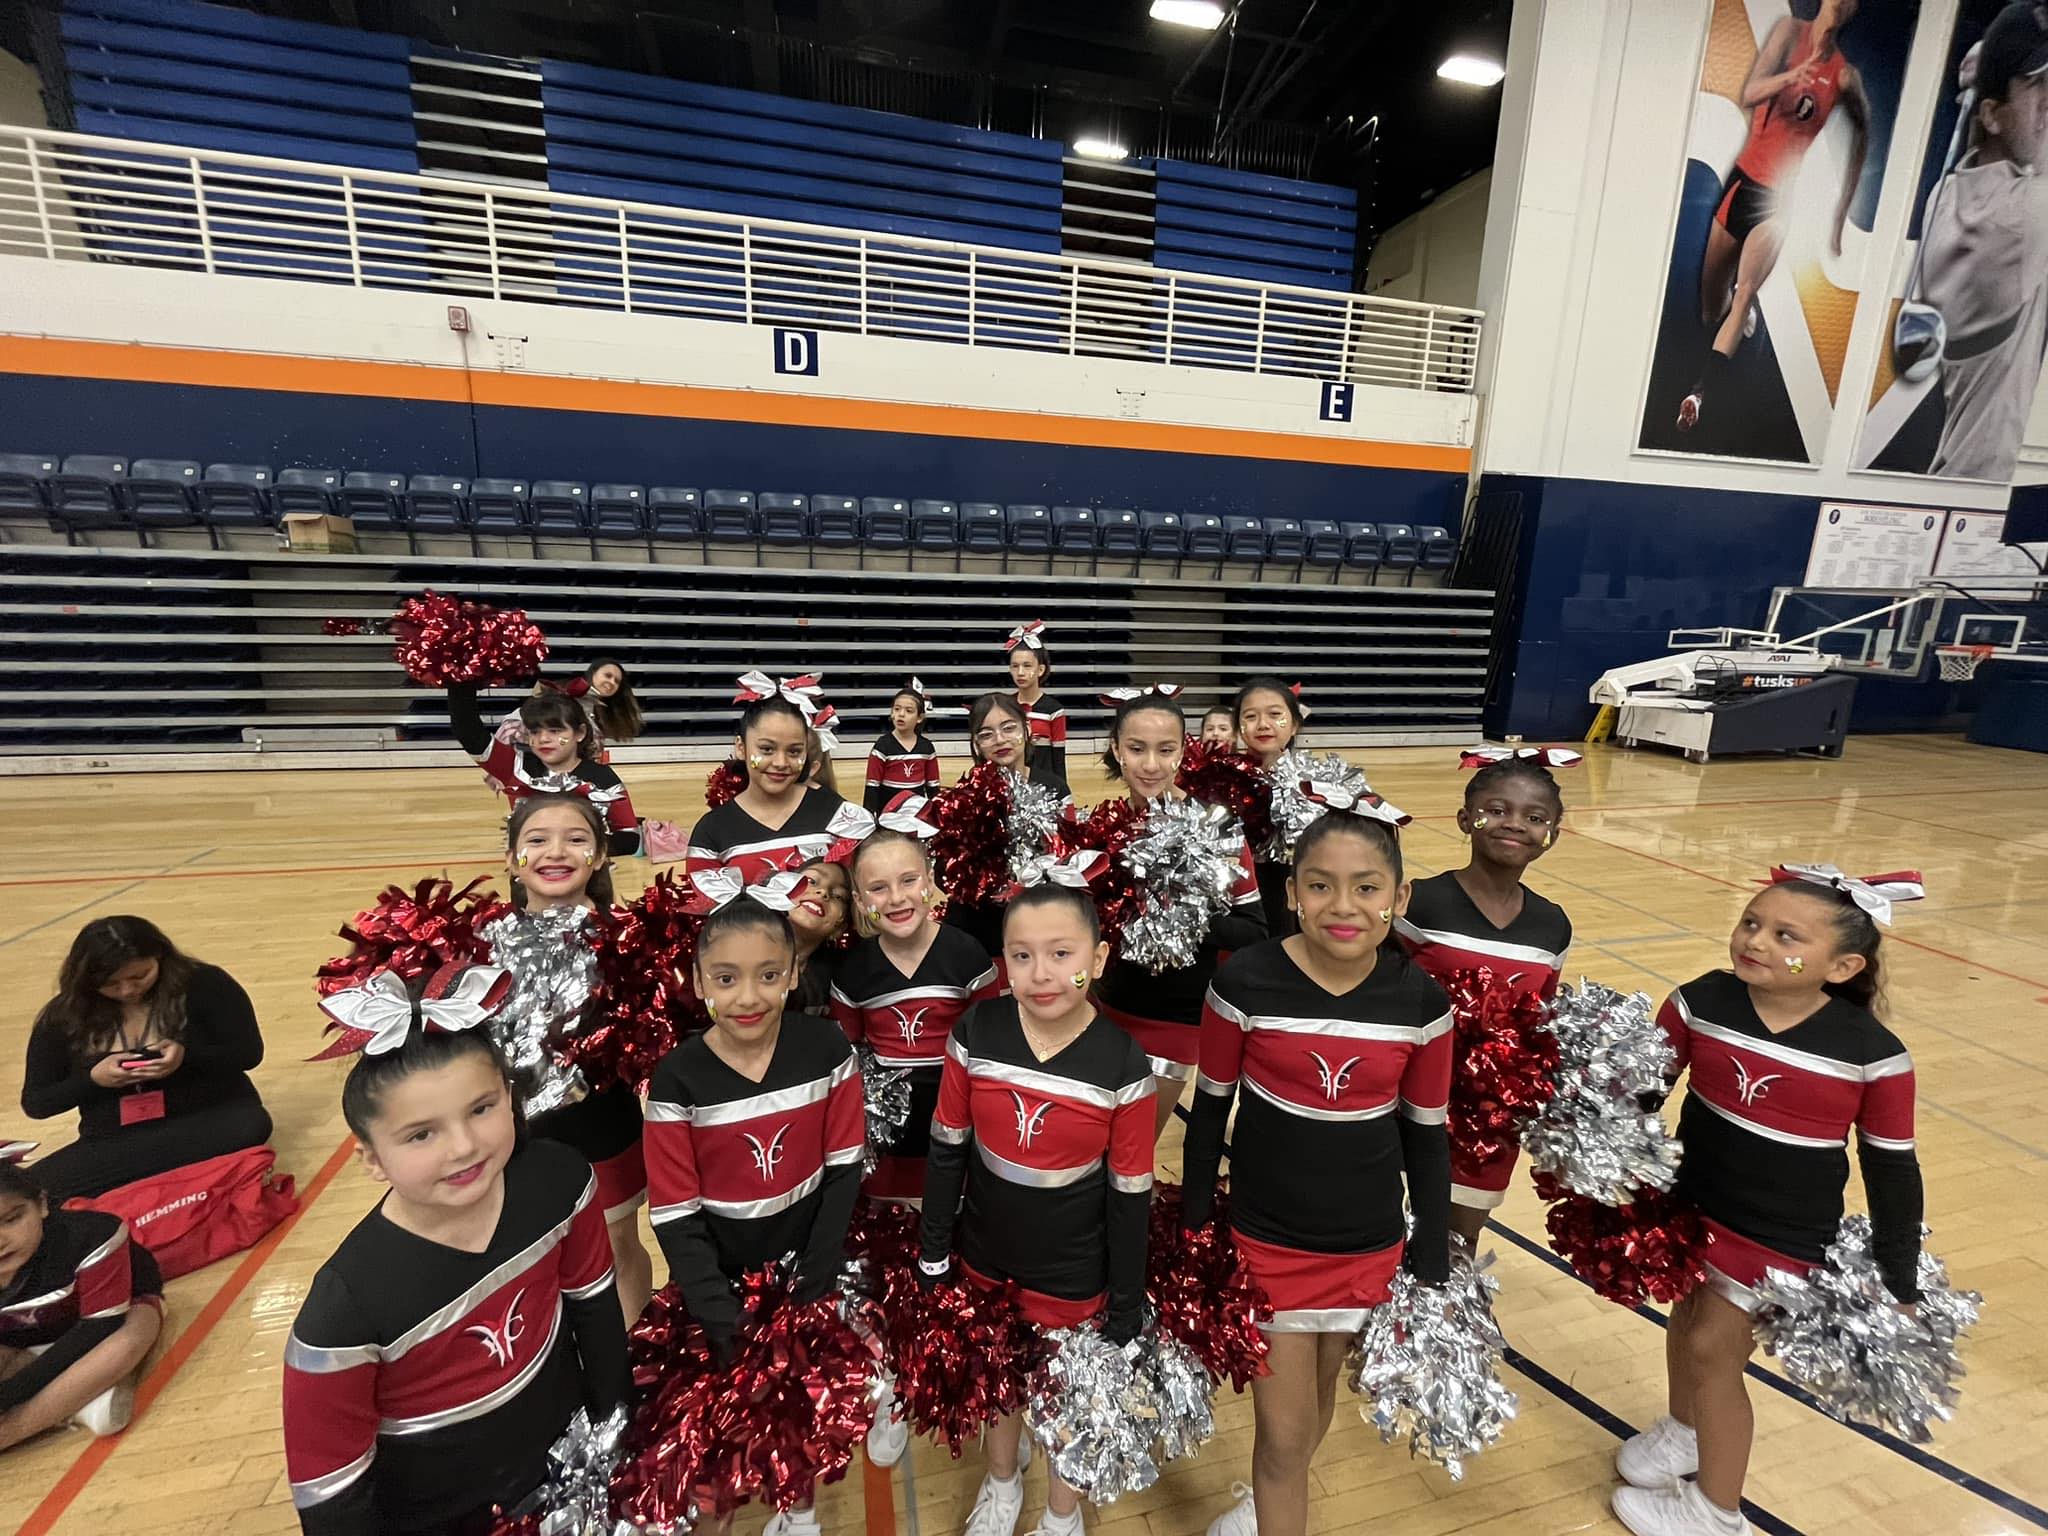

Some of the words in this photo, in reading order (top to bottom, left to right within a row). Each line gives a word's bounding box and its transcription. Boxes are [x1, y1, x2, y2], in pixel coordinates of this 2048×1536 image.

[783, 331, 809, 372] D
[1329, 384, 1345, 419] E
[135, 1191, 208, 1228] HEMMING
